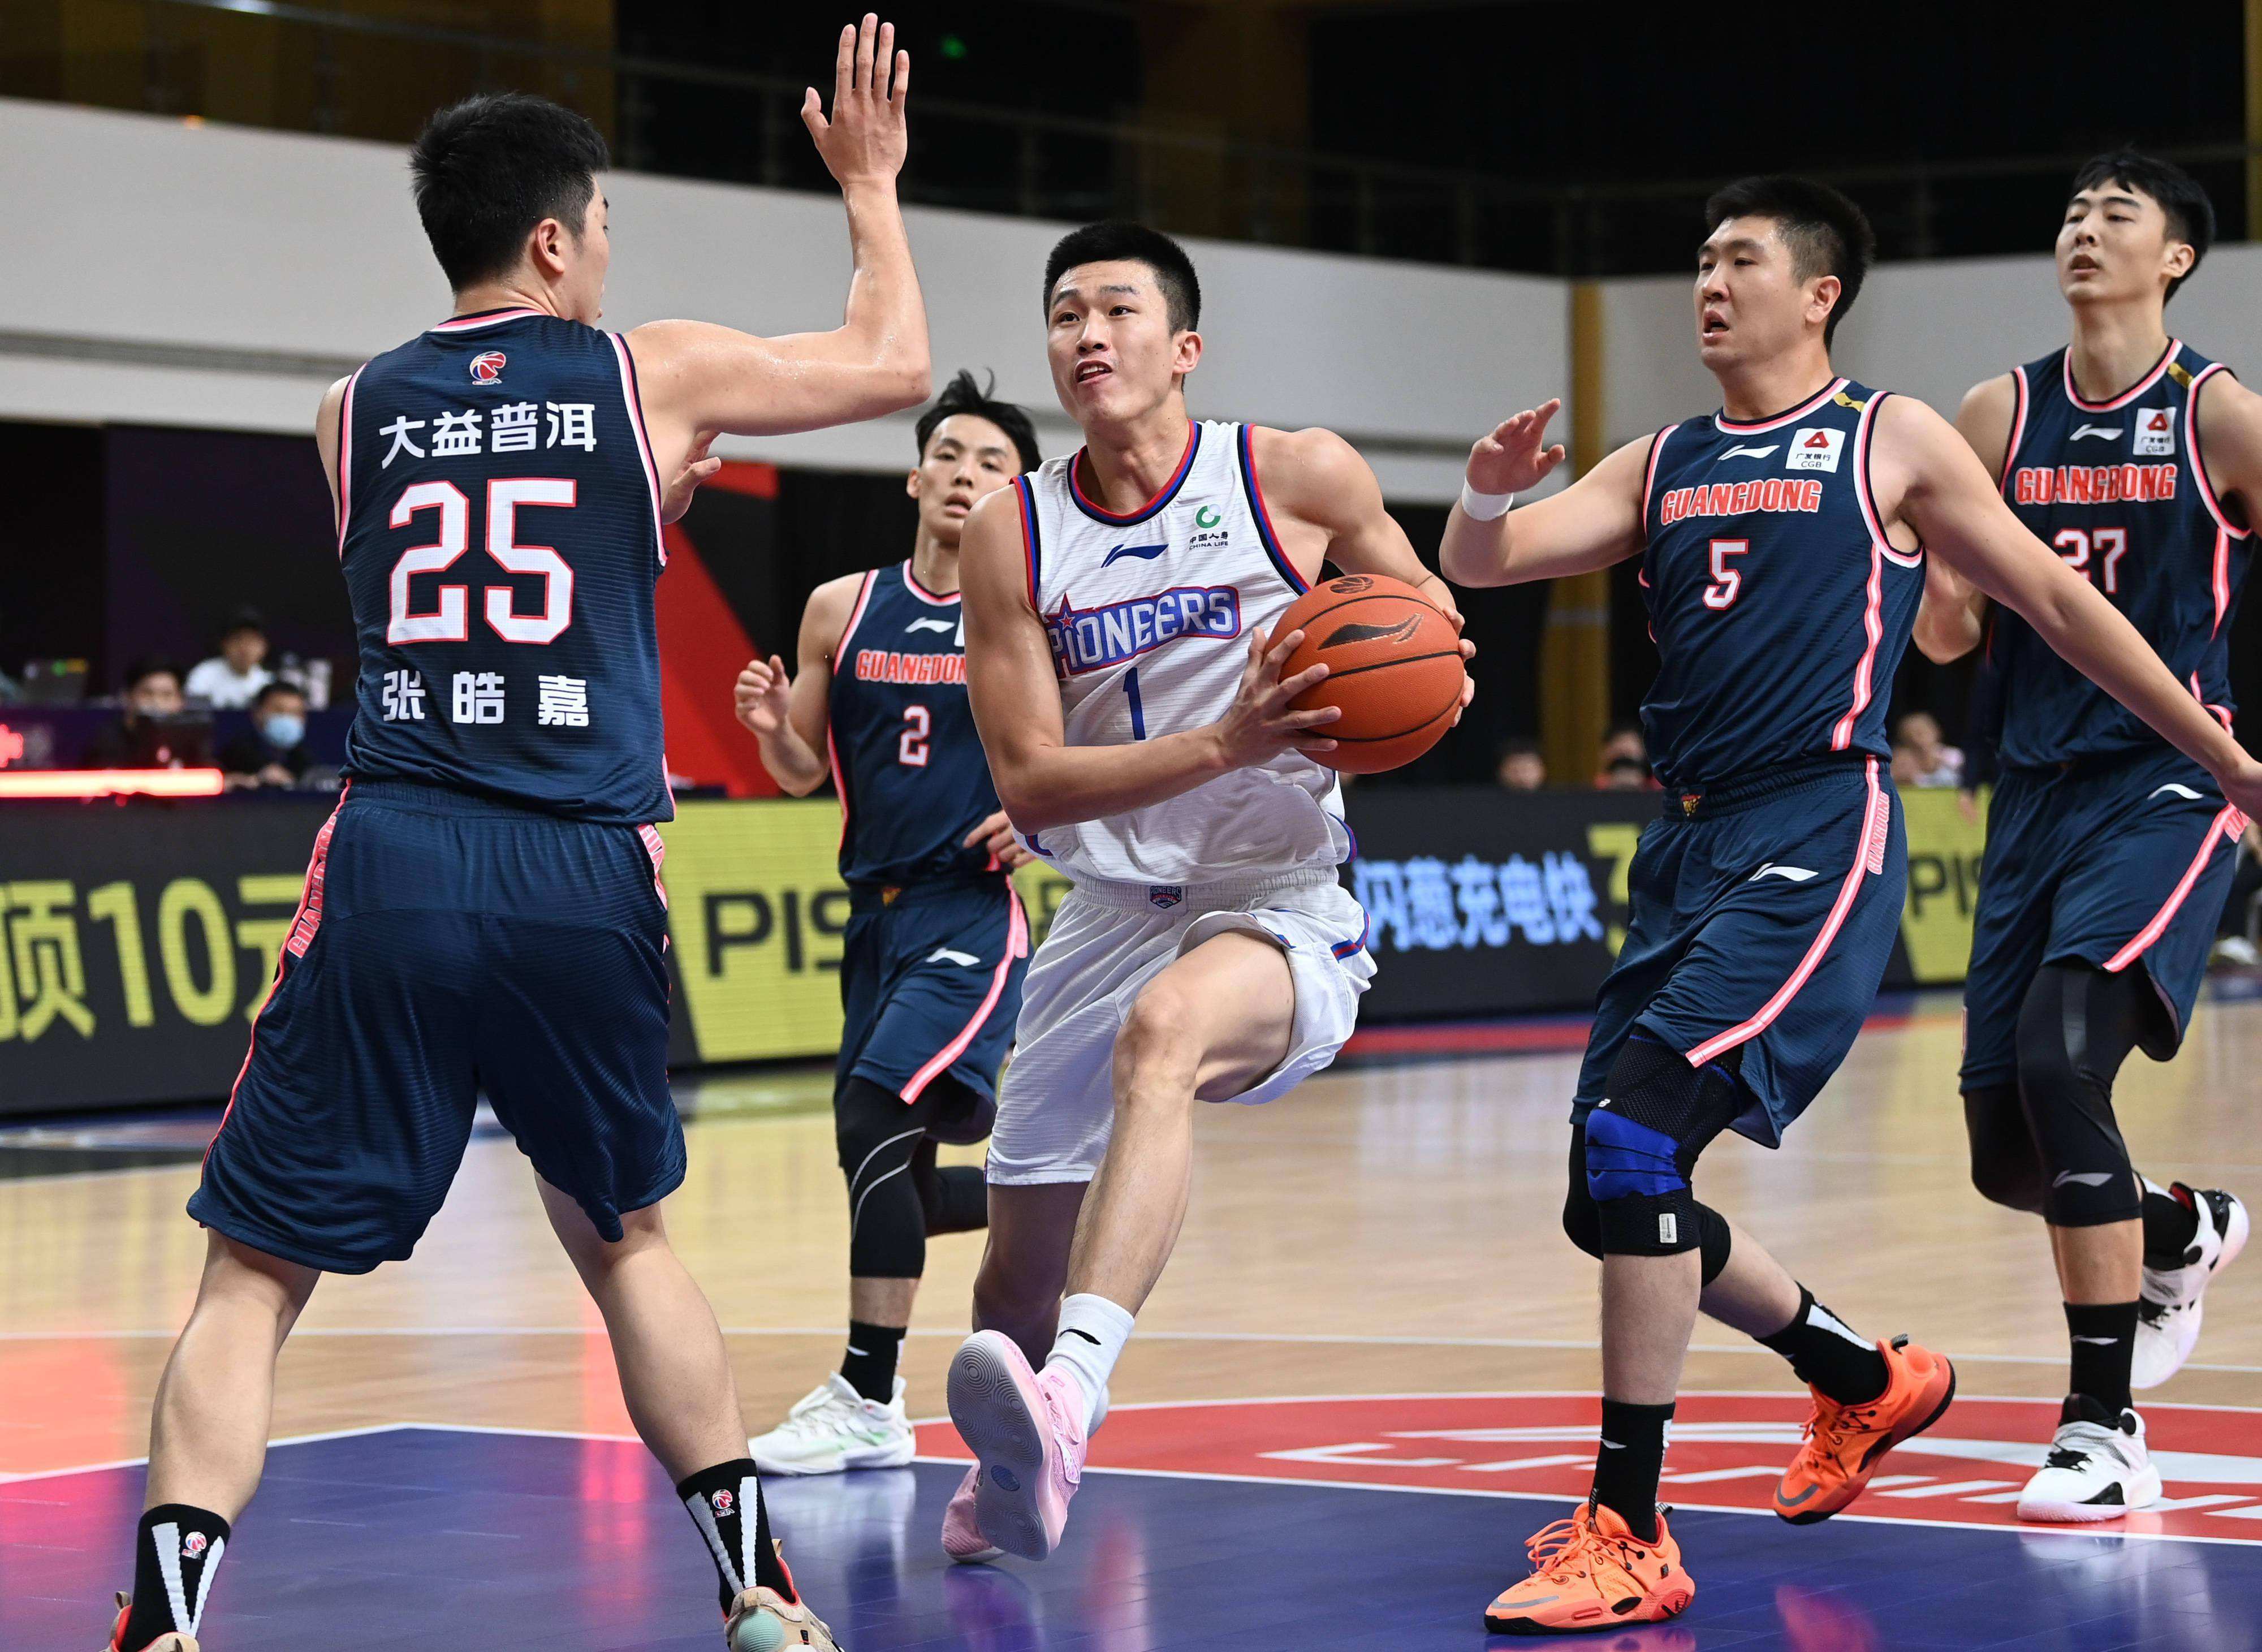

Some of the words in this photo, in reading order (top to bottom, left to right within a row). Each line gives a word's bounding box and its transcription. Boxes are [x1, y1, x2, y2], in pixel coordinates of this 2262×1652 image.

[379, 401, 597, 469] 大益普洱
[1661, 478, 1823, 525] GUANGDONG
[387, 478, 577, 645] 25
[1189, 531, 1228, 544] 中国人寿
[1702, 539, 1749, 610] 5
[1047, 591, 1233, 668] PIONEERS
[382, 670, 590, 727] 张皓嘉
[1123, 667, 1146, 740] 1
[899, 705, 930, 767] 2
